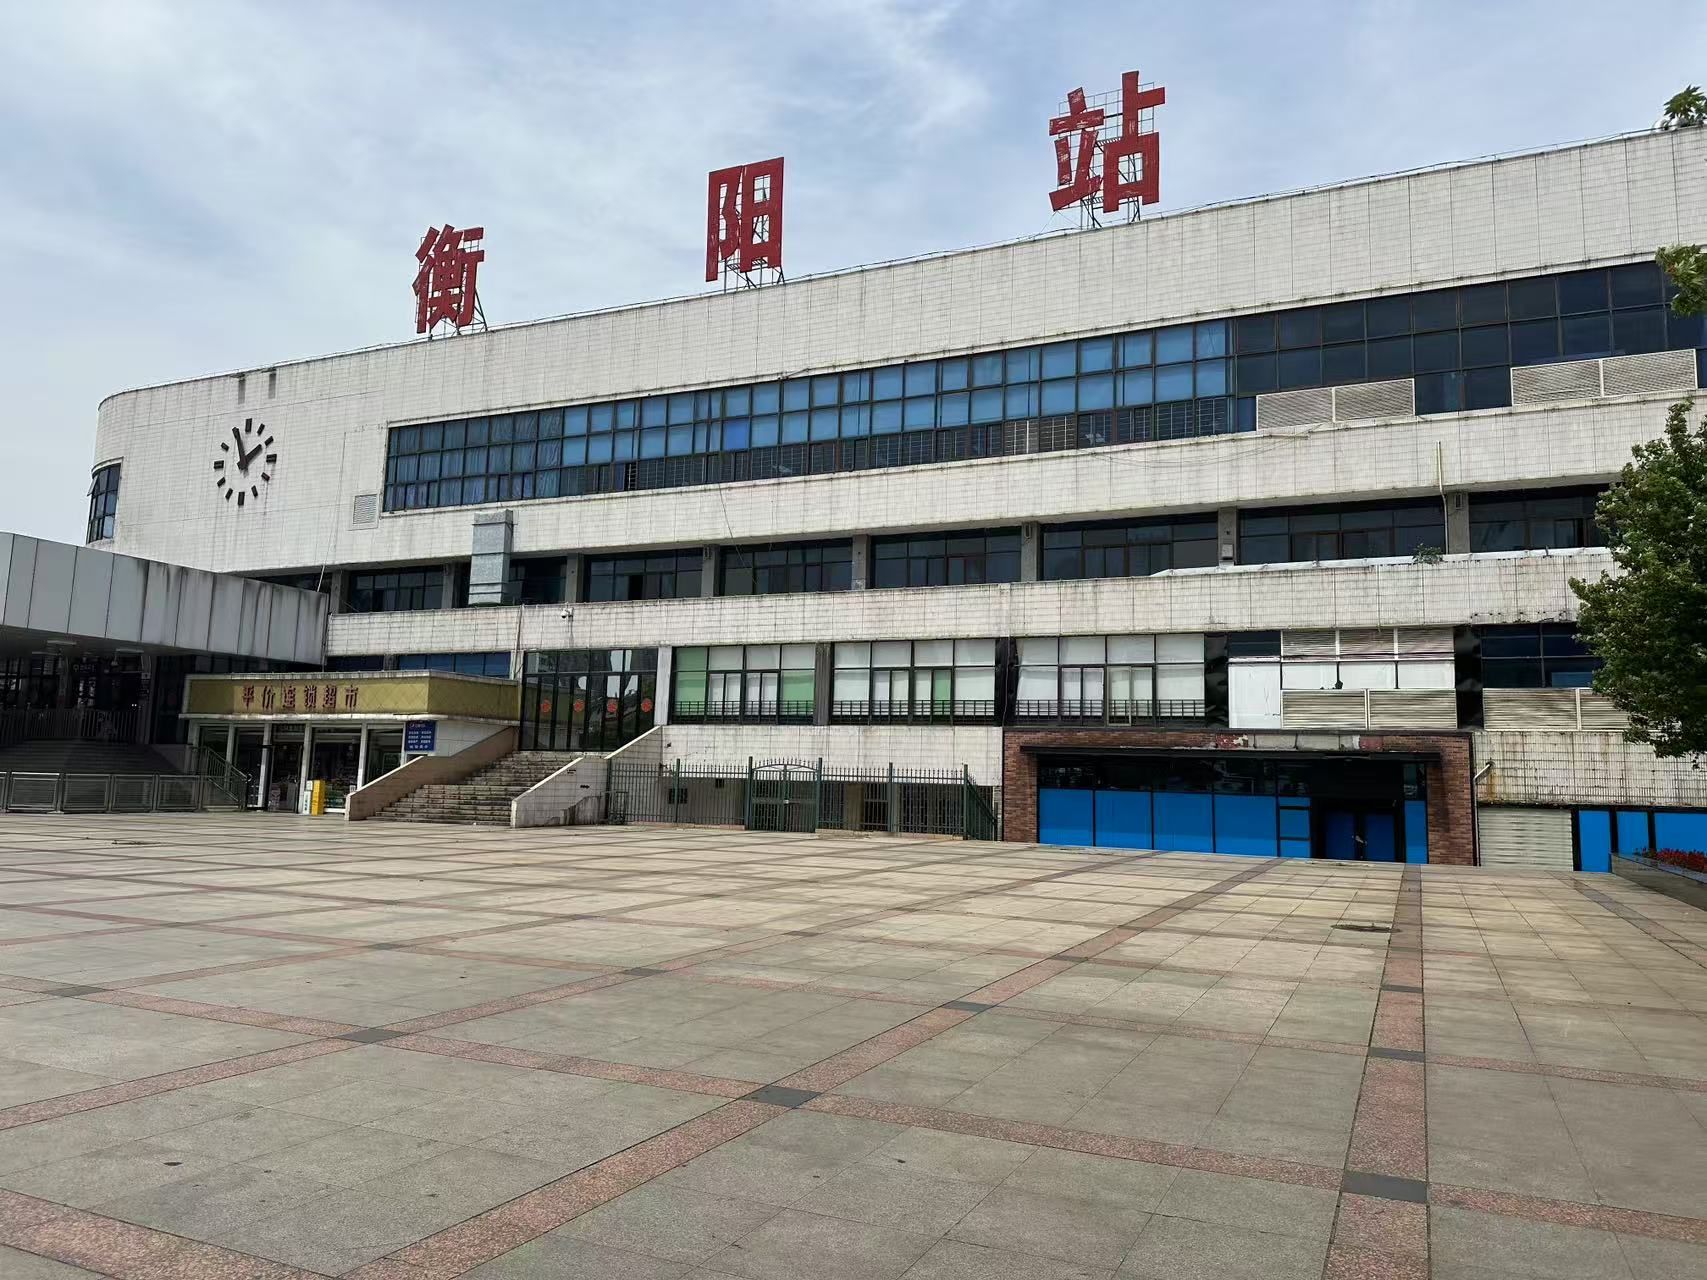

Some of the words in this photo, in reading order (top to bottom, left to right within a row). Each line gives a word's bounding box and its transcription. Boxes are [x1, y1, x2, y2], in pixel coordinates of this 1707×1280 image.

[413, 71, 1166, 334] 衡阳站
[243, 684, 359, 711] 平价连锁超市
